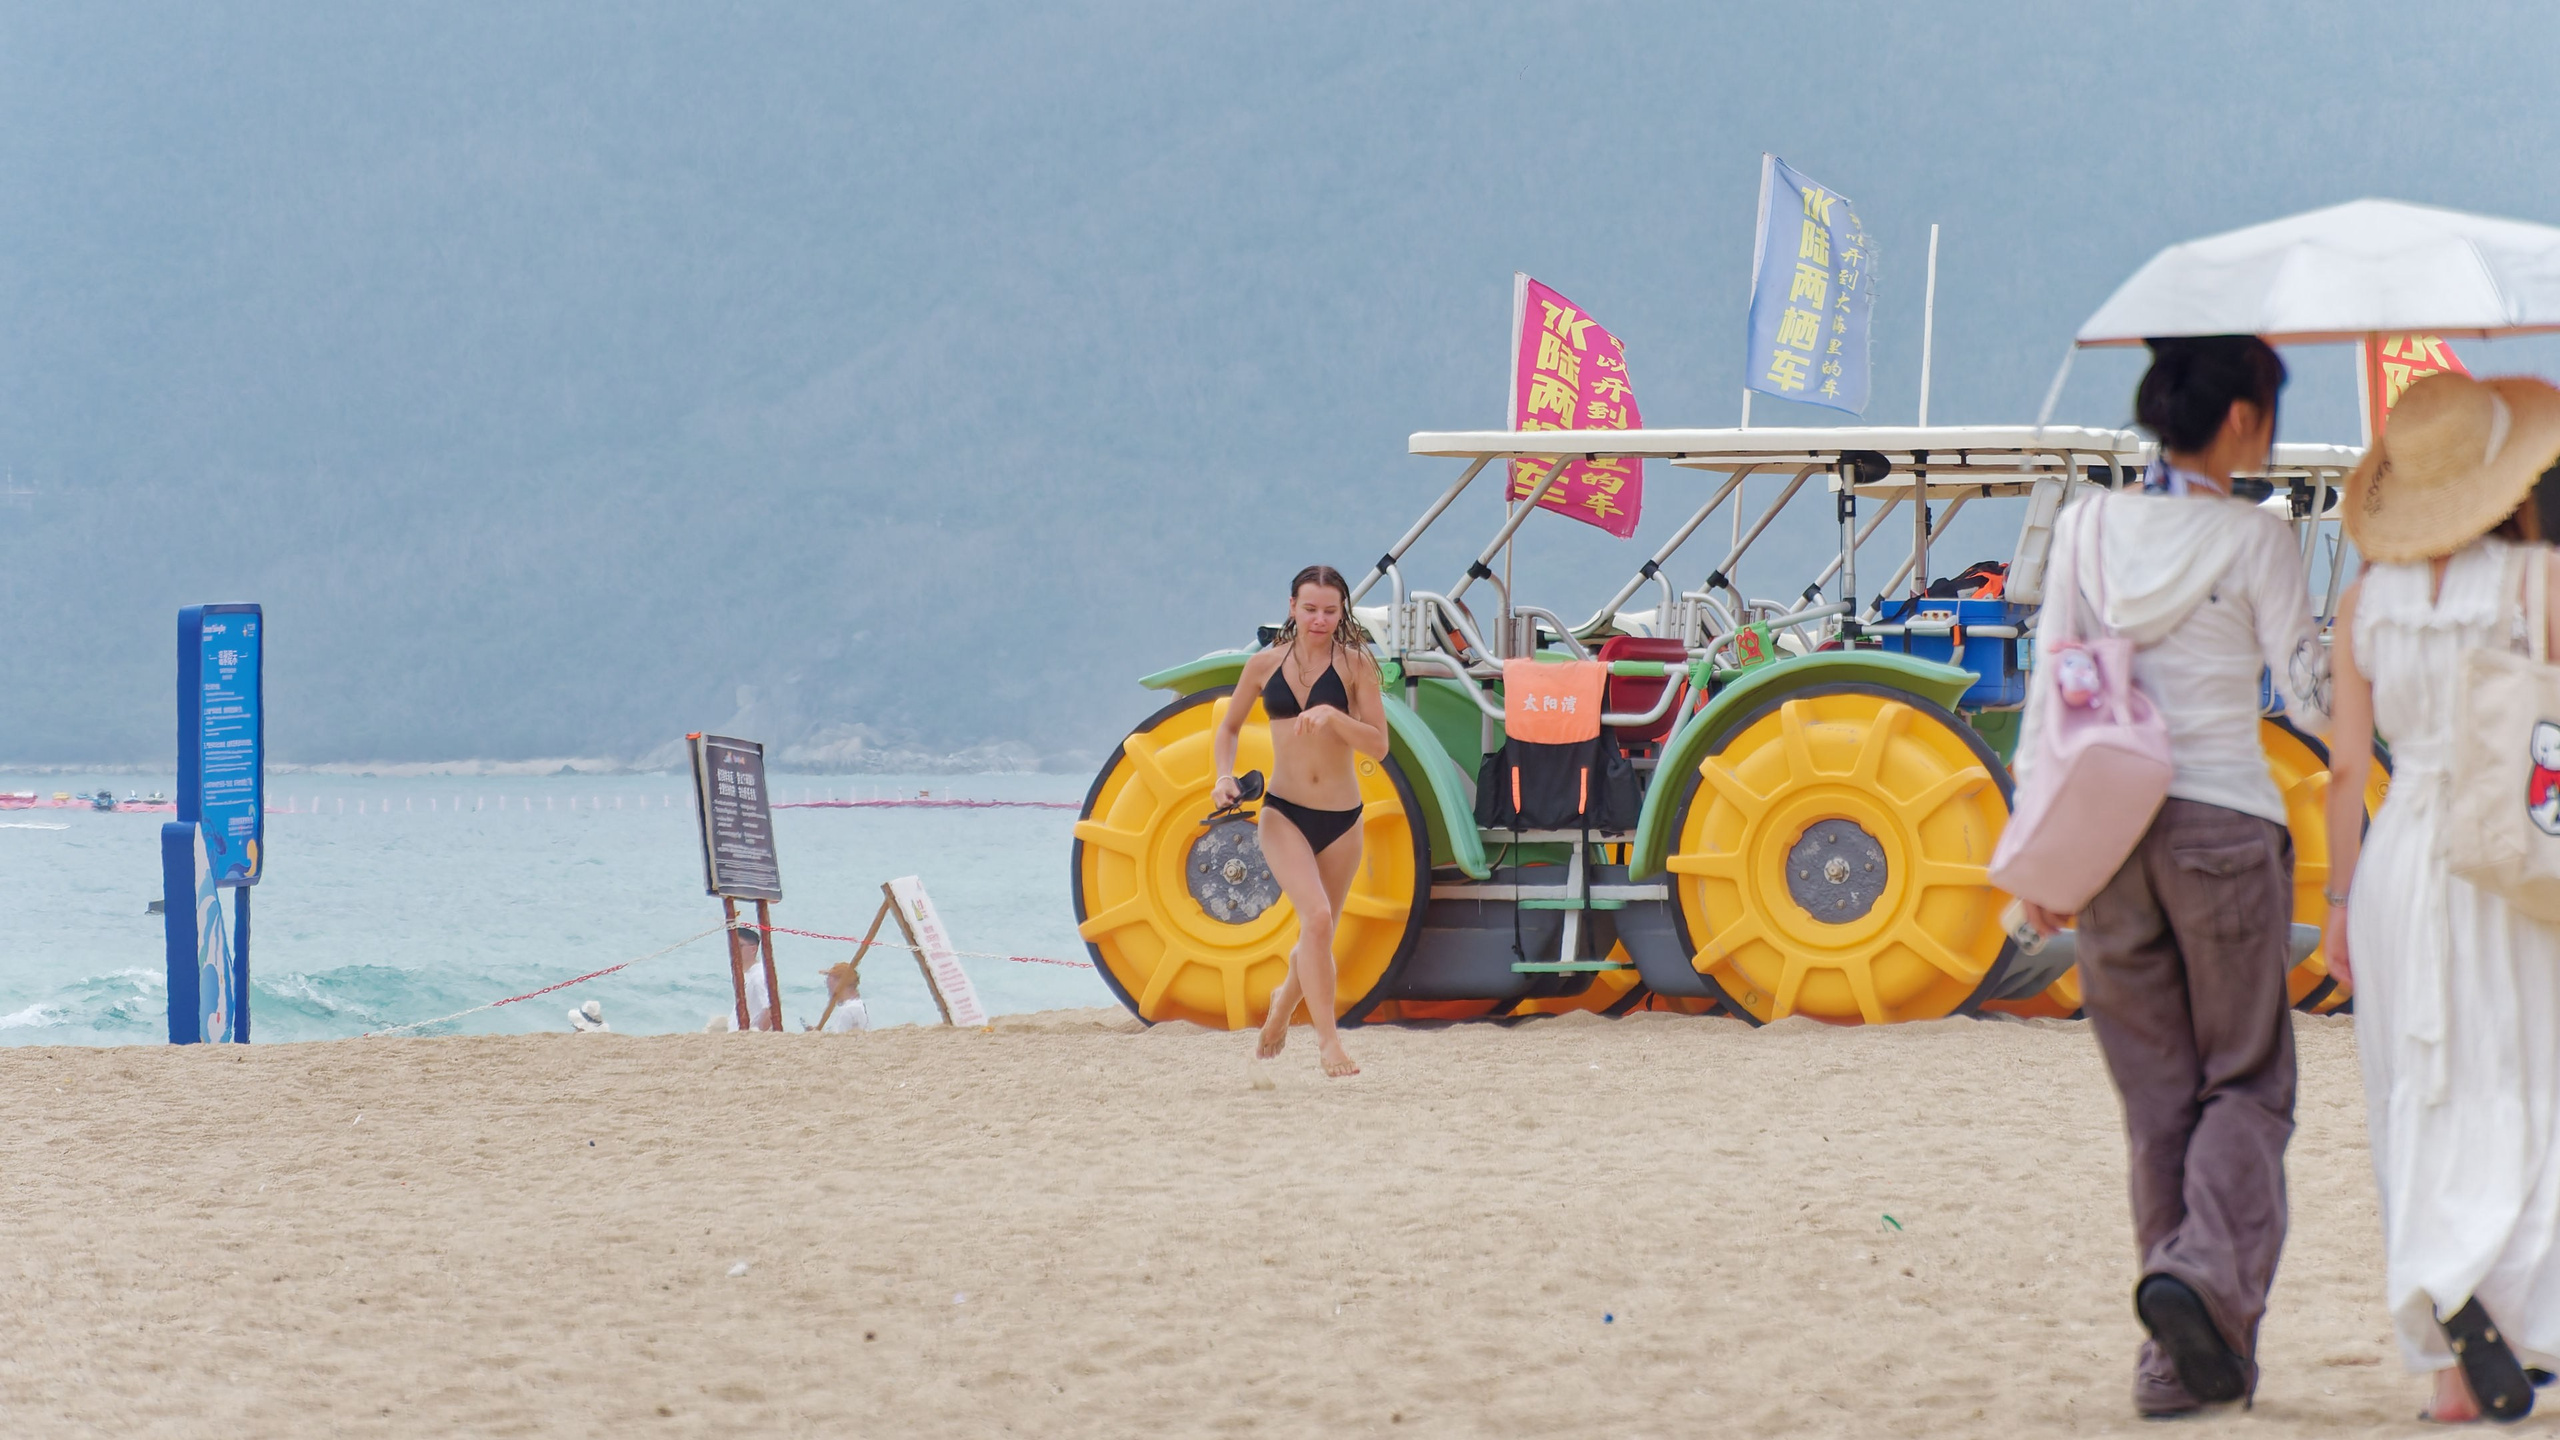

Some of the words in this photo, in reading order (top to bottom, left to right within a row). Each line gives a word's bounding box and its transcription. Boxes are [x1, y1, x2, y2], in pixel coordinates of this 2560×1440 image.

[1767, 187, 1836, 392] 水陆两栖车
[1522, 693, 1577, 714] 太阳湾
